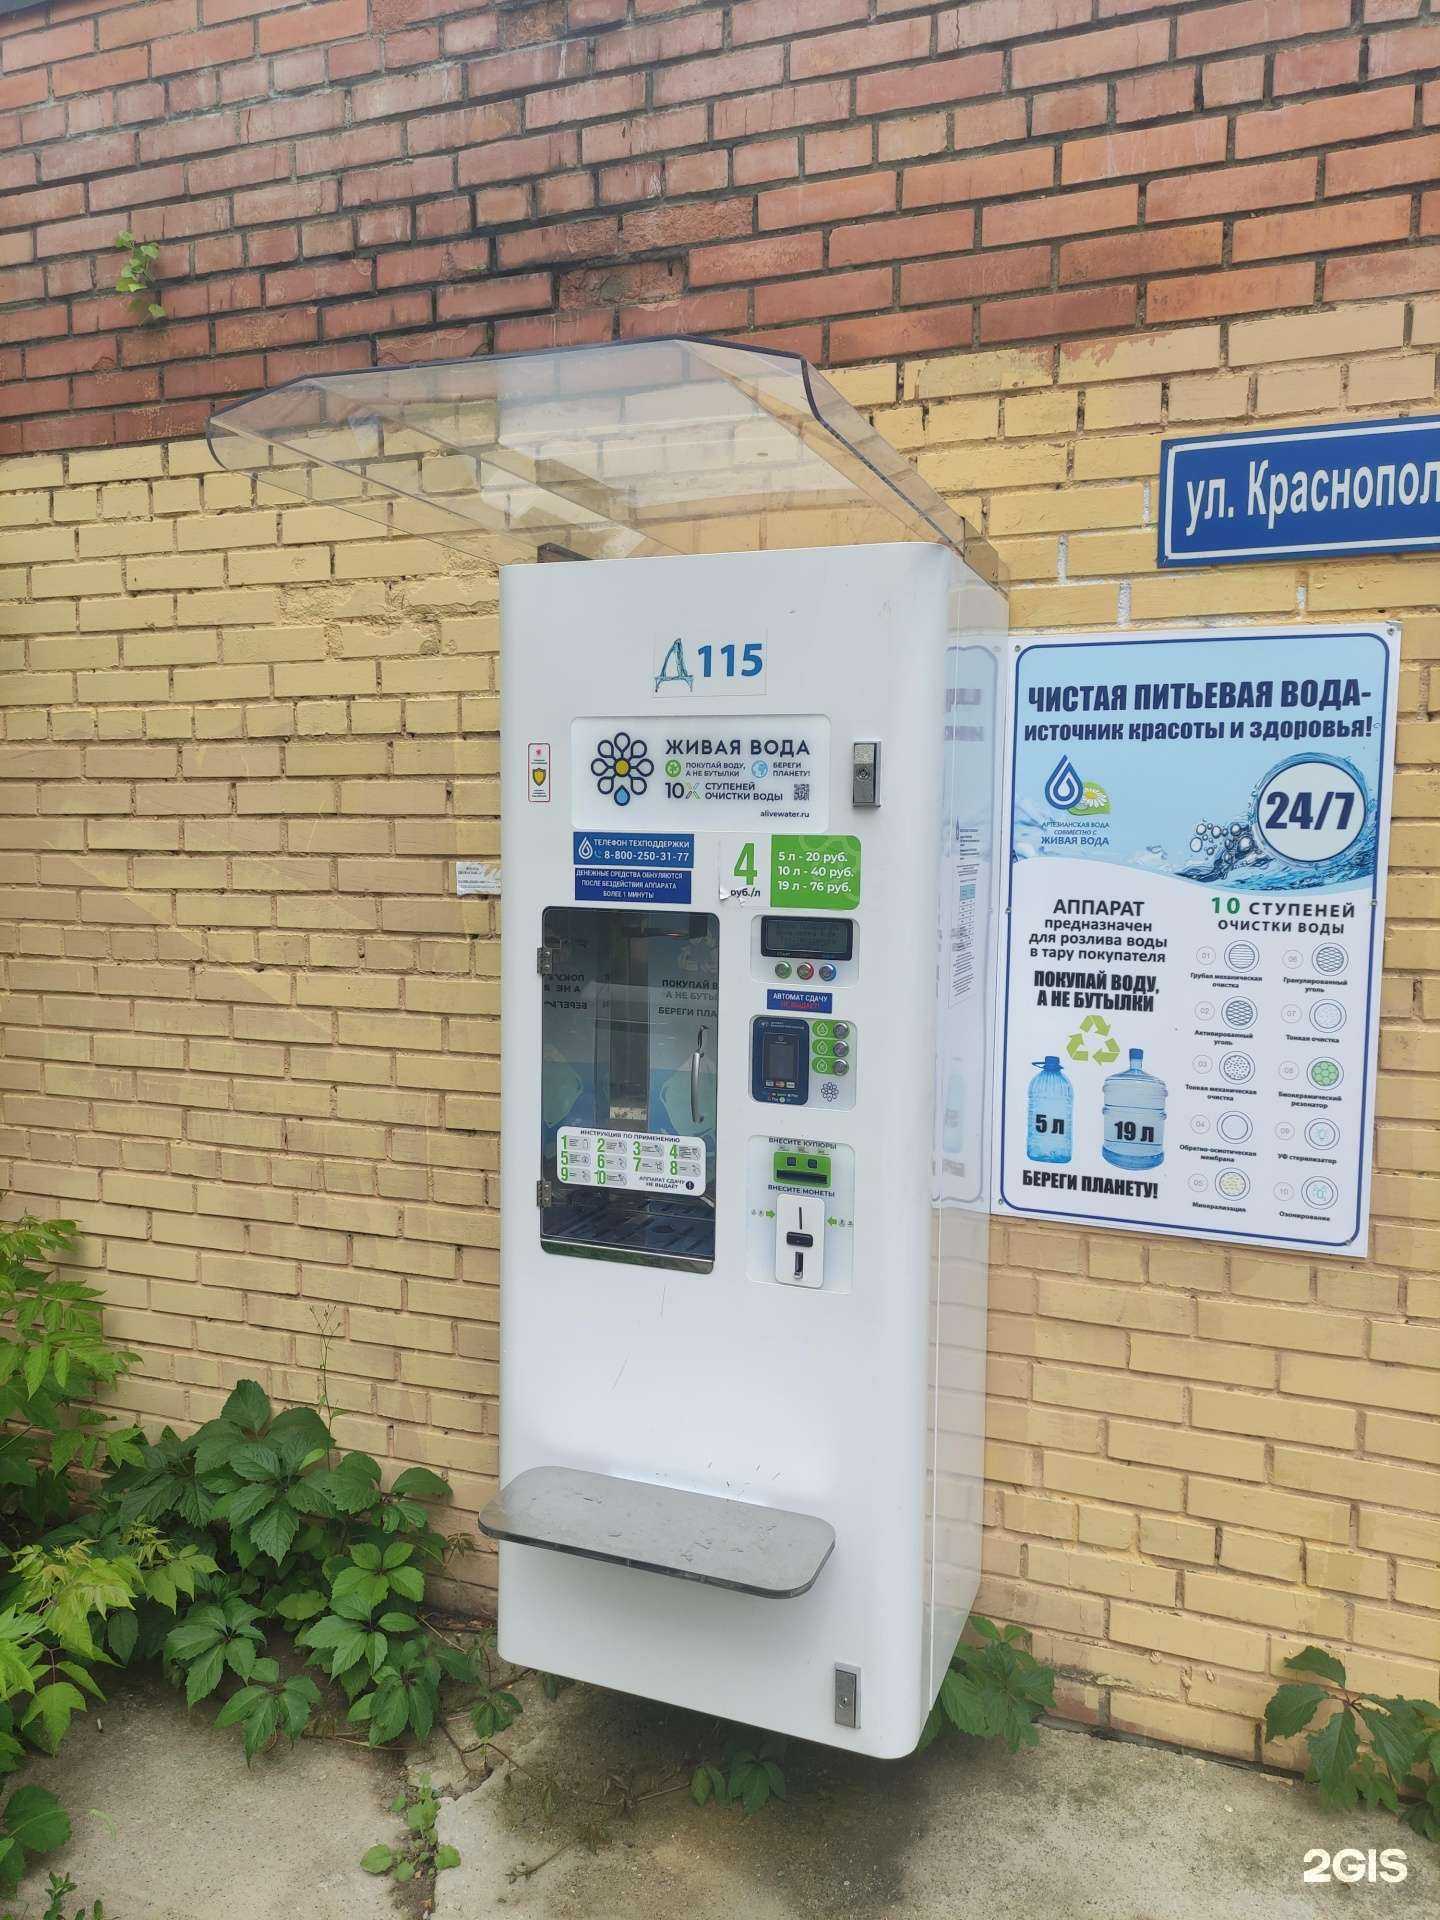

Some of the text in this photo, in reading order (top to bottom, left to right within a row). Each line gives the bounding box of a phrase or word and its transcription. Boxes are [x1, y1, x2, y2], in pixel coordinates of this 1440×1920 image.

[1186, 459, 1440, 536] ул. Краснопол
[1028, 684, 1127, 712] ЧИСТАЯ
[1134, 680, 1273, 710] ПИТЬЕВАЯ
[1024, 716, 1373, 742] источник красоты и здоровья!
[665, 739, 810, 758] ЖИВАЯ ВОДА
[685, 761, 746, 770] ПОКУПАЙ ВОДУ,
[705, 781, 755, 791] СТУПЕНЕЙ
[704, 792, 783, 802] ОЧИСТКИ ВОДЫ
[760, 810, 810, 818] alivewater.ru
[1266, 792, 1355, 830] 24/7
[593, 838, 690, 848] ТЕЛЕФОН ТЕХПОДДЕРЖКИ
[1041, 836, 1110, 847] ЖИВАЯ ВОДА
[604, 850, 689, 862] 8-800-250-31-77
[778, 852, 786, 861] 5
[806, 852, 820, 861] 20
[823, 852, 848, 864] руб.
[734, 842, 758, 886] 4
[610, 870, 641, 878] СРЕДСТВА
[778, 866, 790, 876] 10
[792, 868, 800, 876] л
[810, 867, 826, 877] 40
[829, 867, 854, 879] руб.
[602, 880, 644, 888] БЕЗДЕЙСТВИЯ
[778, 880, 790, 890] 19
[792, 882, 800, 890] л
[810, 882, 824, 892] 76
[827, 882, 852, 894] руб.
[603, 890, 622, 898] БОЛЕЕ
[627, 891, 655, 899] МИНУТЫ
[1053, 899, 1145, 917] АППАРАТ
[1211, 896, 1356, 918] 10 СТУПЕНЕЙ
[1044, 919, 1152, 932] предназначен
[1218, 919, 1344, 936] ОЧИСТКИ ВОДЫ
[1028, 933, 1168, 949] для розлива воды
[1030, 948, 1166, 964] в тару покупателя
[1034, 970, 1160, 994] ПОКУПАЙ ВОДУ,
[1190, 972, 1263, 982] Грубая механическая
[1283, 976, 1348, 986] Гранулированный
[662, 979, 710, 990] ПОКУПАЙ
[675, 992, 688, 1000] НЕ
[773, 992, 828, 1003] АВТОМАТ СДАЧУ
[1037, 990, 1154, 1012] А НЕ БУТЫЛКИ
[658, 1006, 694, 1016] БЕРЕГИ
[1194, 1030, 1254, 1038] Активированный
[1311, 1036, 1340, 1044] очистка
[1209, 1087, 1258, 1096] механическая
[1278, 1091, 1343, 1102] Биокерамический
[1290, 1100, 1328, 1110] резонатор
[1036, 1114, 1064, 1134] 5 л
[580, 1129, 622, 1138] ИНСТРУКЦИЯ
[634, 1134, 681, 1143] ПРИМЕНЕНИЮ
[1114, 1120, 1154, 1142] 19 л
[560, 1134, 568, 1150] 1
[596, 1138, 606, 1153] 2
[632, 1140, 641, 1156] 3
[768, 1137, 837, 1150] ВНЕСИТЕ КУПЮРЫ
[560, 1150, 568, 1166] 5
[670, 1144, 679, 1160] 4
[1200, 1154, 1235, 1163] мембрана
[597, 1154, 605, 1169] 6
[632, 1157, 642, 1172] 7
[1289, 1155, 1338, 1165] стерилизатор
[560, 1166, 568, 1182] 9
[670, 1160, 678, 1176] 8
[594, 1170, 606, 1185] 10
[1022, 1169, 1159, 1199] БЕРЕГИ ПЛАНЕТУ!
[768, 1184, 835, 1197] ВНЕСИТЕ МОНЕТЫ
[1192, 1201, 1247, 1213] Минерализация
[1278, 1211, 1331, 1222] Озонирование
